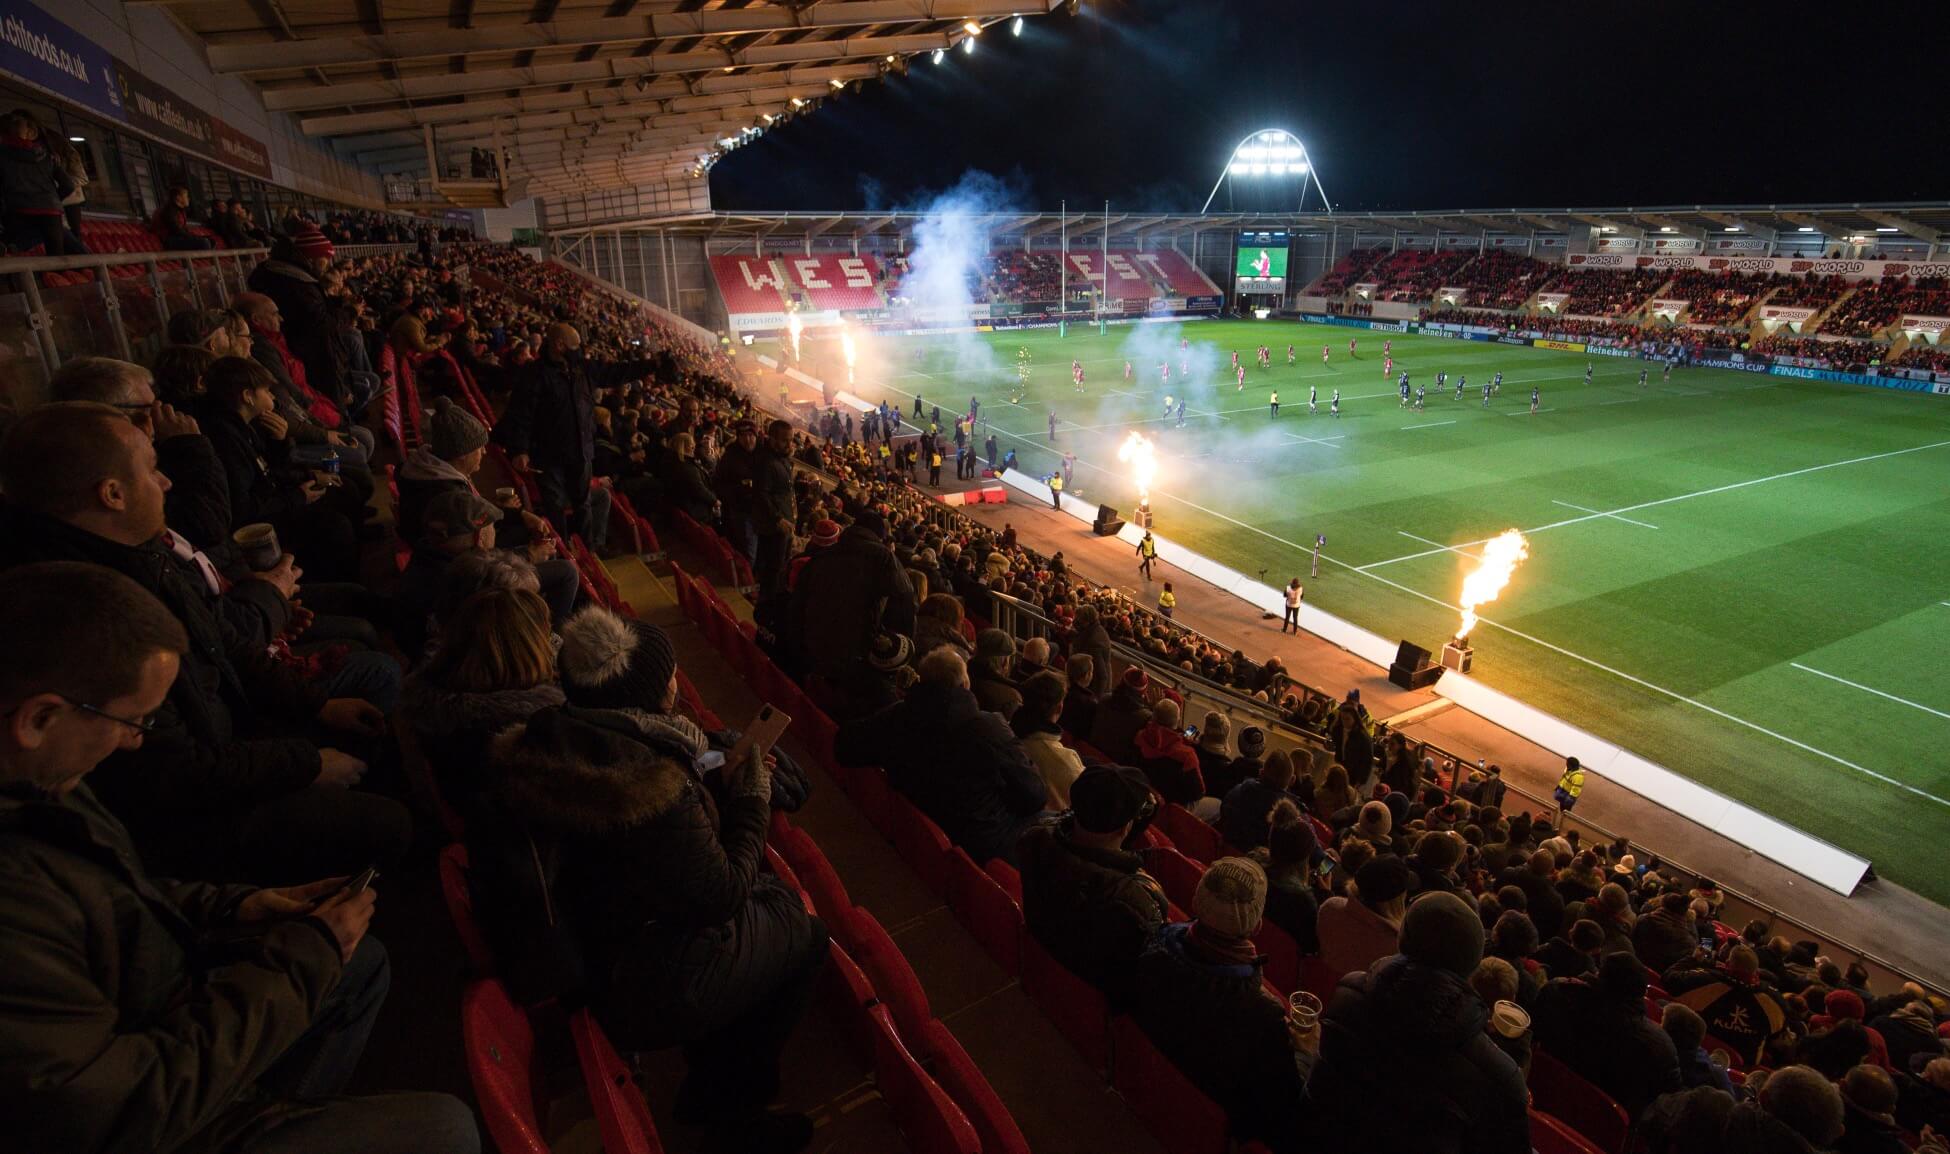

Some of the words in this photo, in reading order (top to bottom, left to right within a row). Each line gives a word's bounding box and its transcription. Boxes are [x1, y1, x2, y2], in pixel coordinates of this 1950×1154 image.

[1587, 255, 1622, 266] WORLD
[1655, 257, 1694, 268] WORLD
[1730, 259, 1774, 271] WORLD
[1815, 261, 1864, 274] WORLD
[1911, 264, 1950, 277] WOR
[1418, 326, 1453, 338] Heineken
[1586, 345, 1629, 358] Heineken
[1695, 358, 1745, 370] CHAMPIONS
[1746, 363, 1765, 372] CUP
[1774, 365, 1815, 379] FINALS
